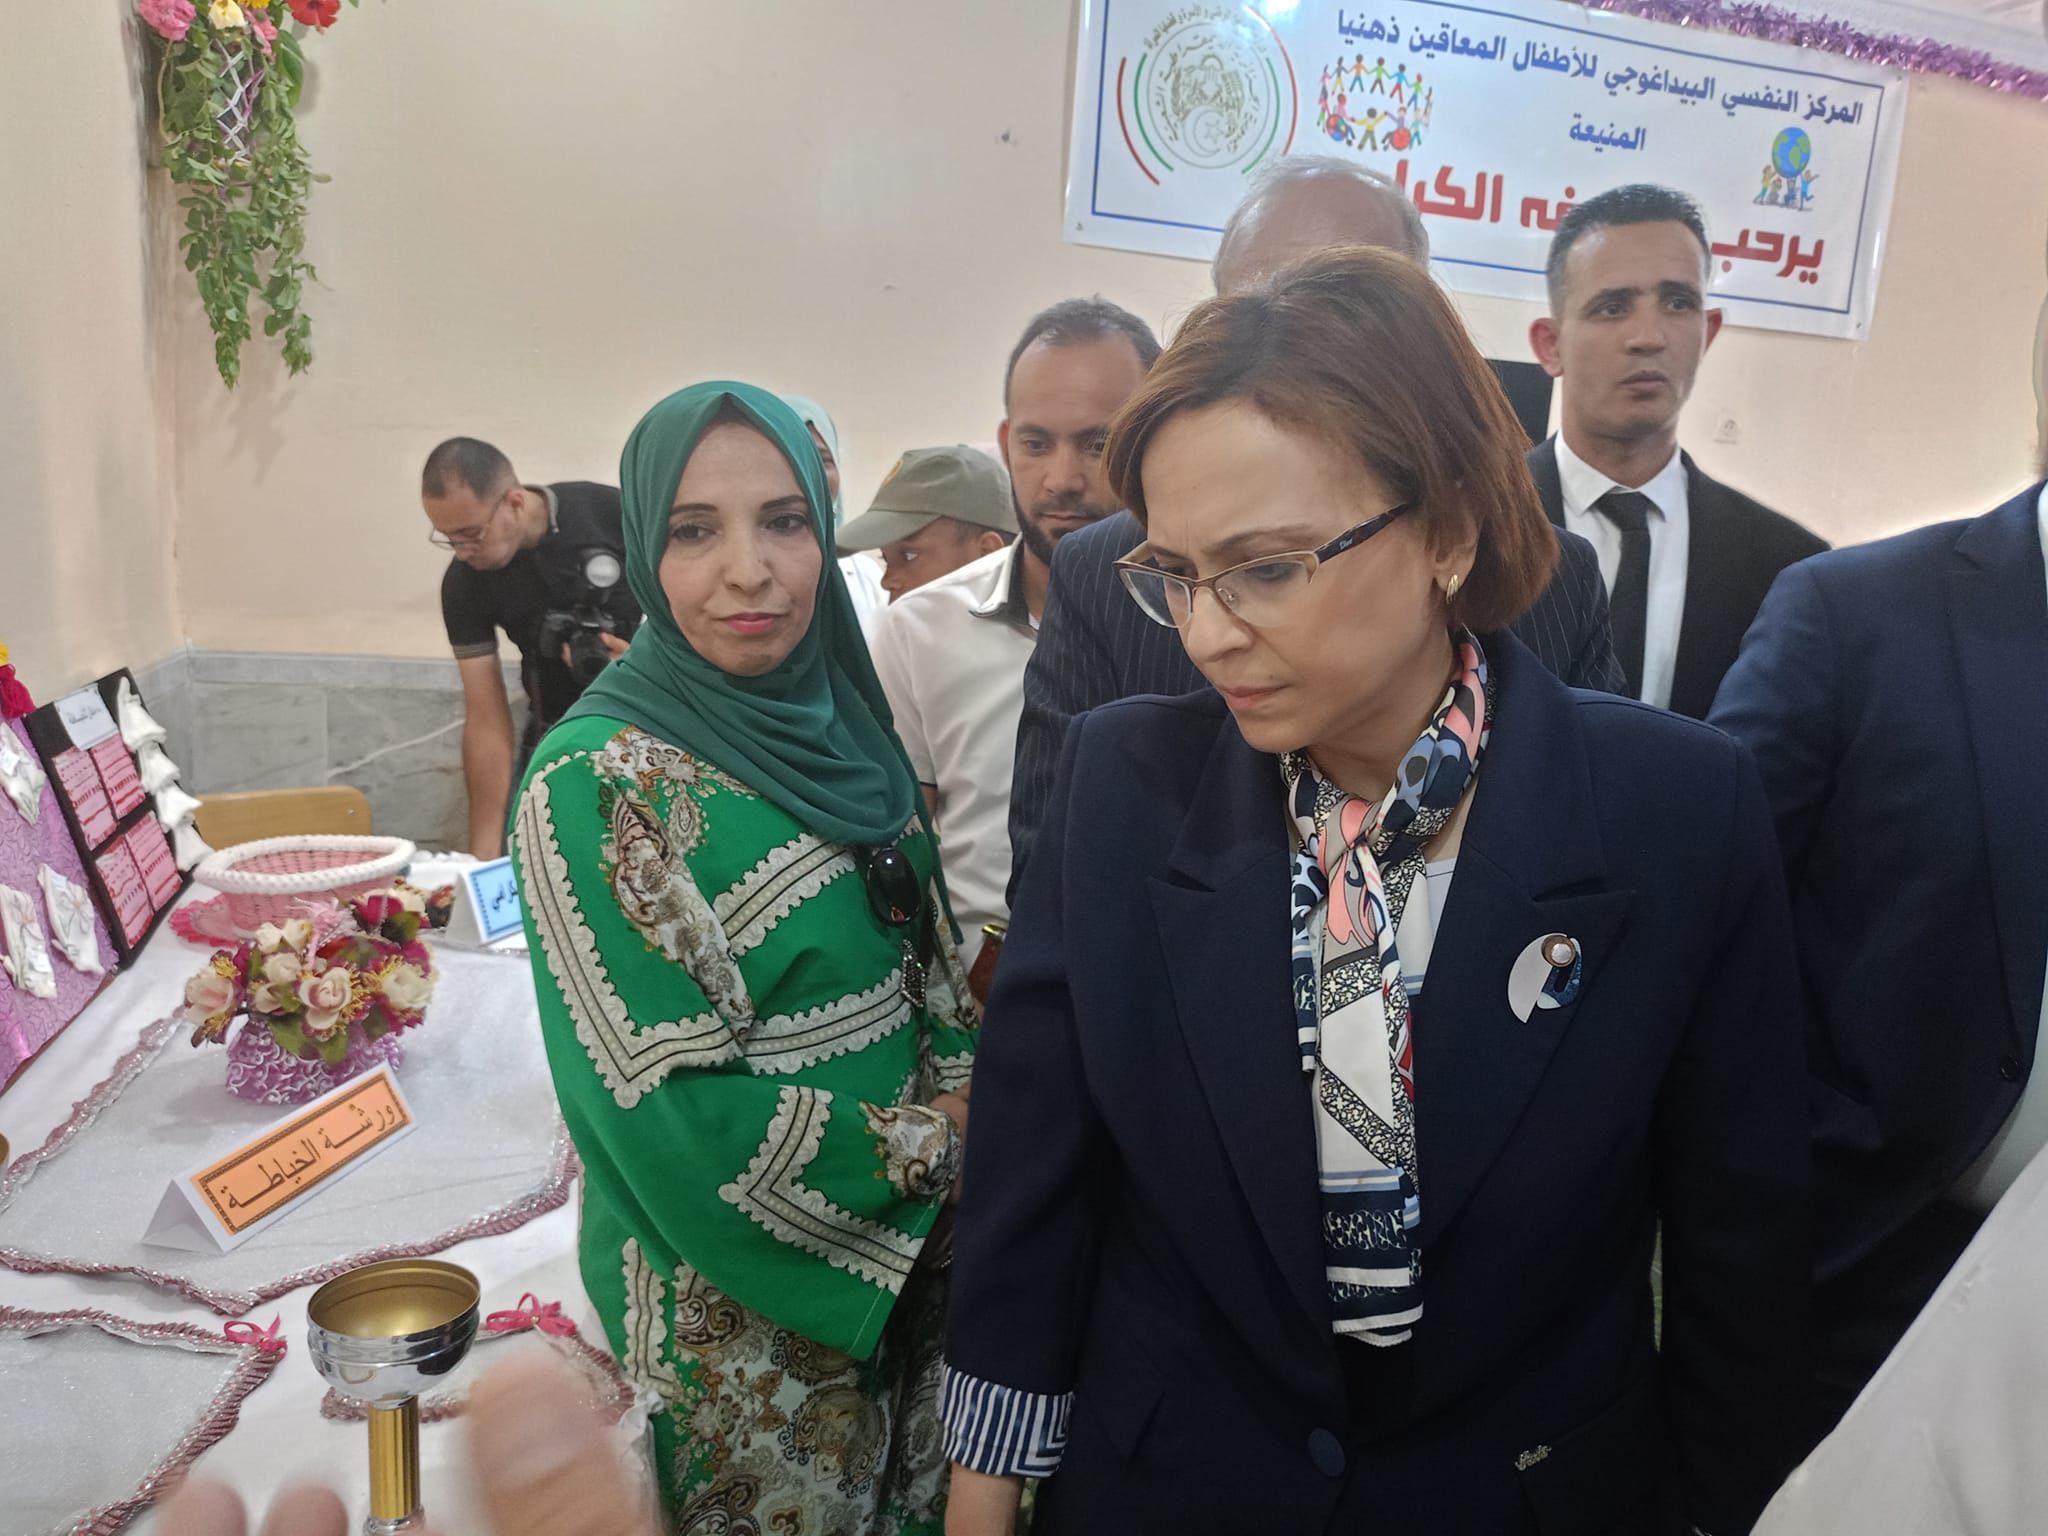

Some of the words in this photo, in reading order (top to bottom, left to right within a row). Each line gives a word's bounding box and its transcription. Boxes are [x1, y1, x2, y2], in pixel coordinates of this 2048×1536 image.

[1337, 9, 1401, 45] ذهنيا
[1408, 22, 1507, 61] المعاقين
[1512, 40, 1598, 79] للأطفال
[1603, 65, 1716, 106] البيداغوجي
[1720, 85, 1799, 117] النفسي
[1803, 94, 1864, 125] المركز
[1569, 112, 1647, 153] المنيعة
[1396, 159, 1504, 223] الكرا
[1710, 228, 1825, 285] يرحب
